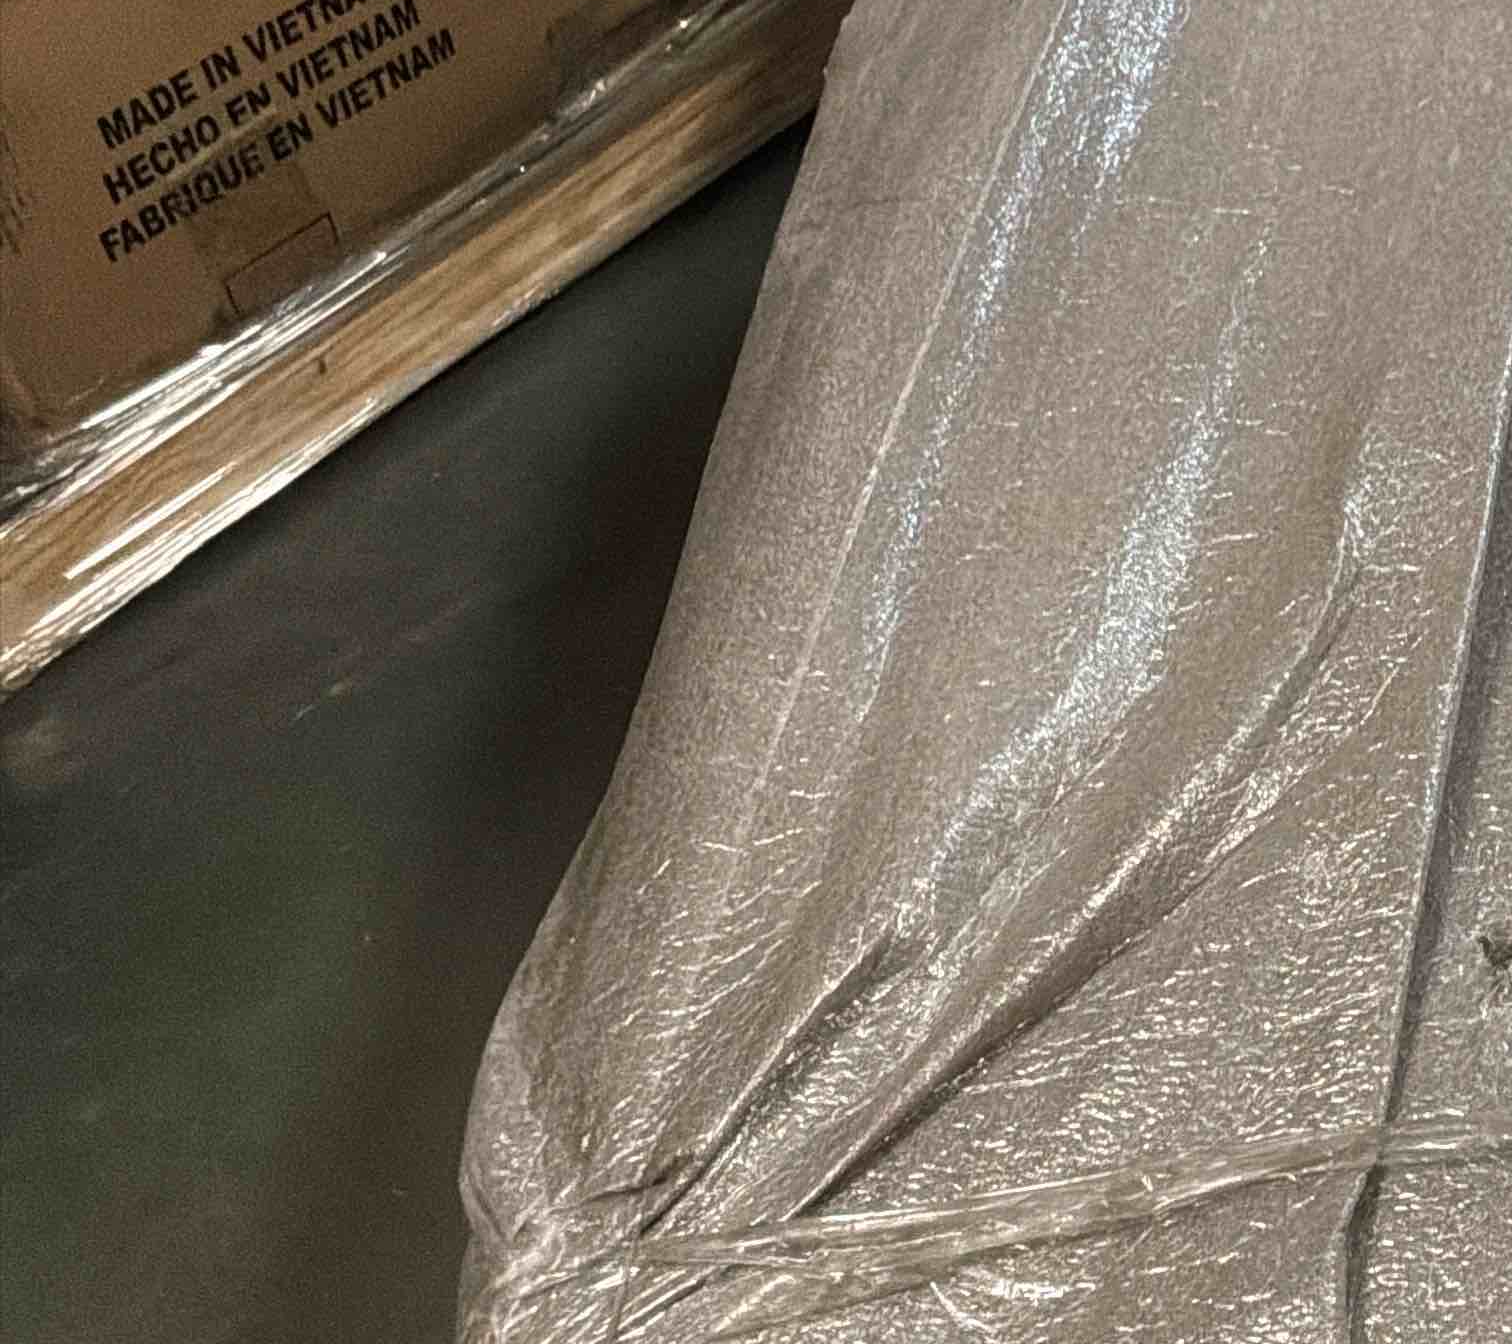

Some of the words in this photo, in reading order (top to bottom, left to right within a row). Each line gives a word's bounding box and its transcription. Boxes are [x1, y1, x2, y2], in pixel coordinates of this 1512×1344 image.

[96, 69, 199, 150] MADE
[200, 45, 242, 91] IN
[99, 143, 265, 263] FABRIQUE
[266, 113, 314, 162] EN
[315, 28, 456, 128] VIETNAM
[102, 114, 221, 205] HECHO
[225, 83, 272, 127] EN
